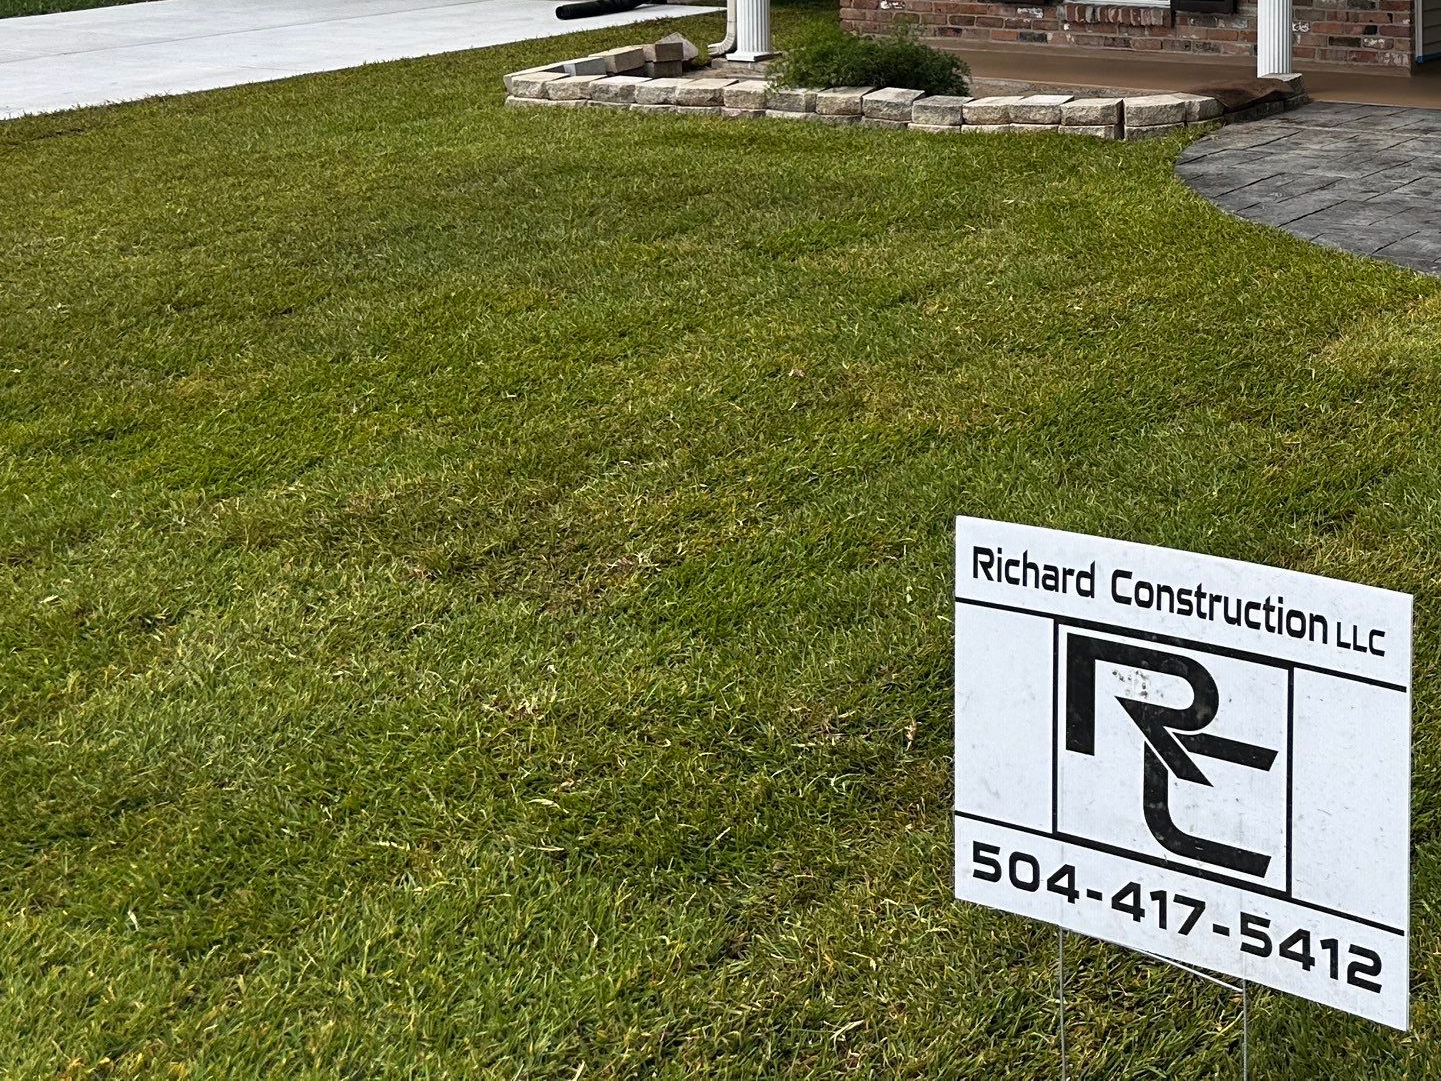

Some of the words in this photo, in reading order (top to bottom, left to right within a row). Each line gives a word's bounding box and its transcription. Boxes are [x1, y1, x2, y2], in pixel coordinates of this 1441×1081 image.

[973, 546, 1095, 599] Richard
[1111, 569, 1328, 644] Construction
[1337, 621, 1386, 657] LLC
[972, 840, 1383, 994] 504-417-5412
